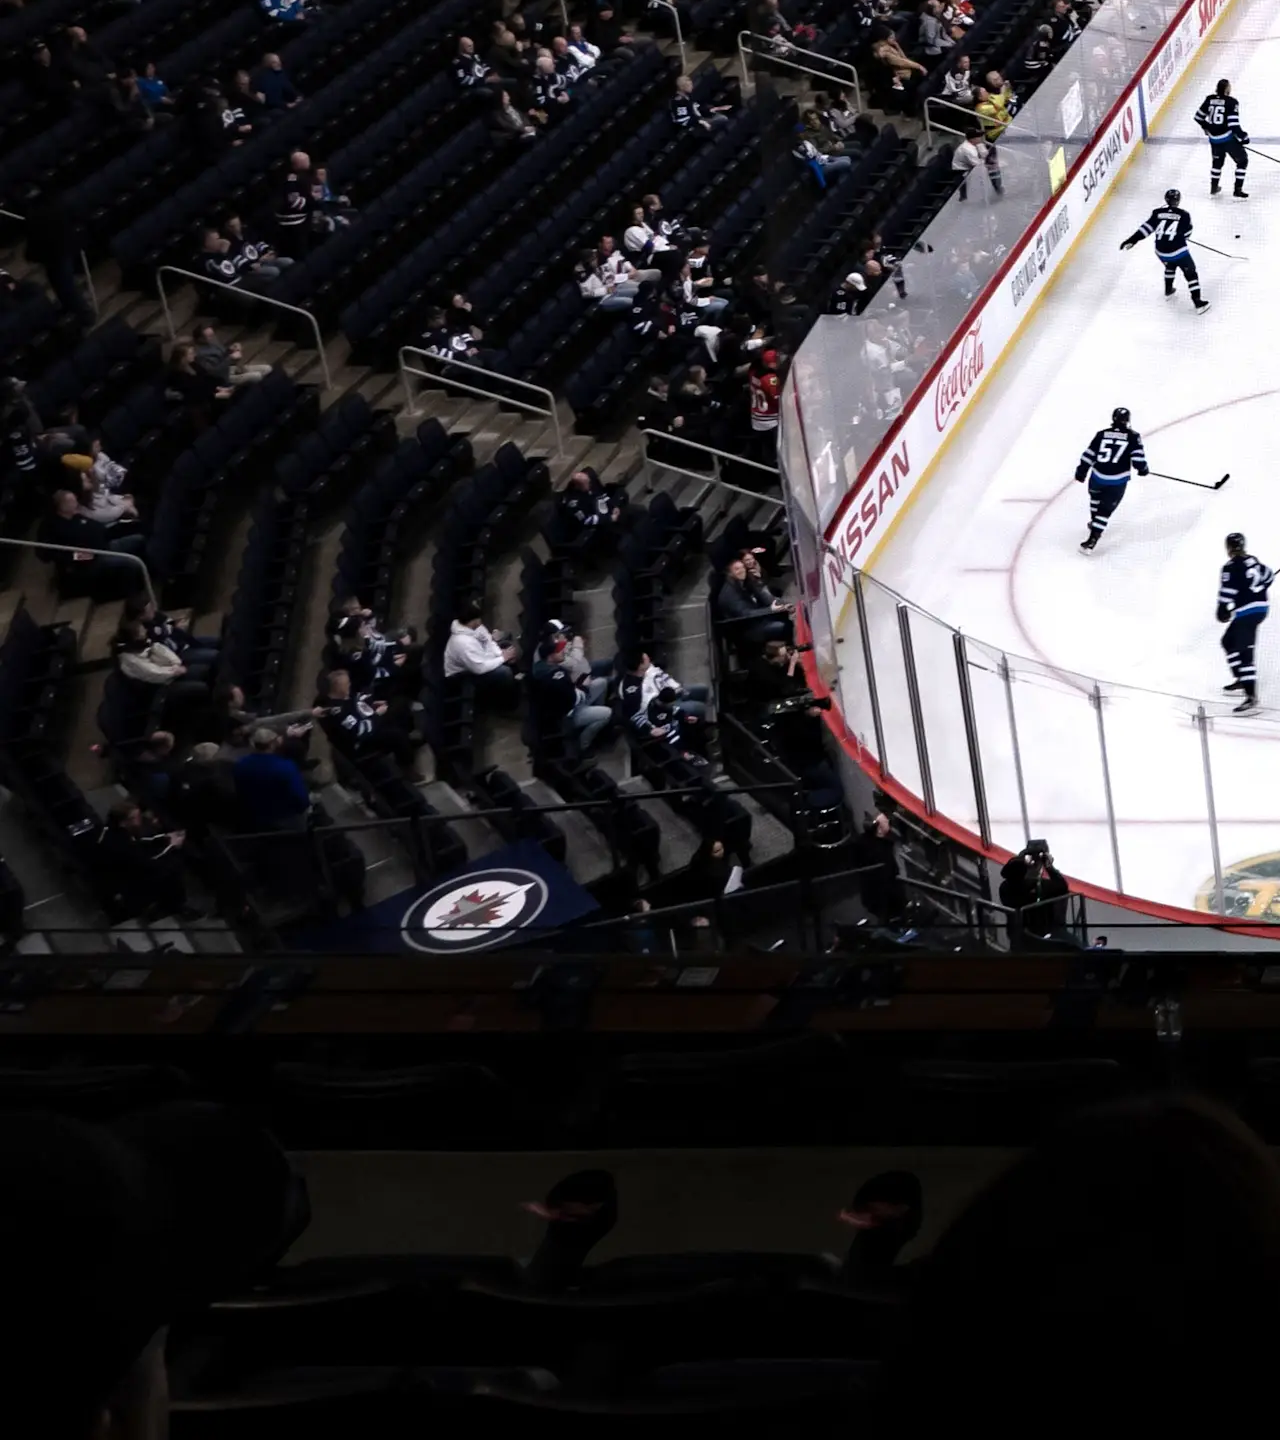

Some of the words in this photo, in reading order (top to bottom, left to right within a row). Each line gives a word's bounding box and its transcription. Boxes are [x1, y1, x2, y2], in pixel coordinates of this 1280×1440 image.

[1082, 130, 1124, 203] SAFEWAY
[1155, 220, 1179, 241] 44
[934, 317, 985, 433] Coca-Cola
[1098, 440, 1129, 463] 57
[827, 440, 911, 596] NISSAN
